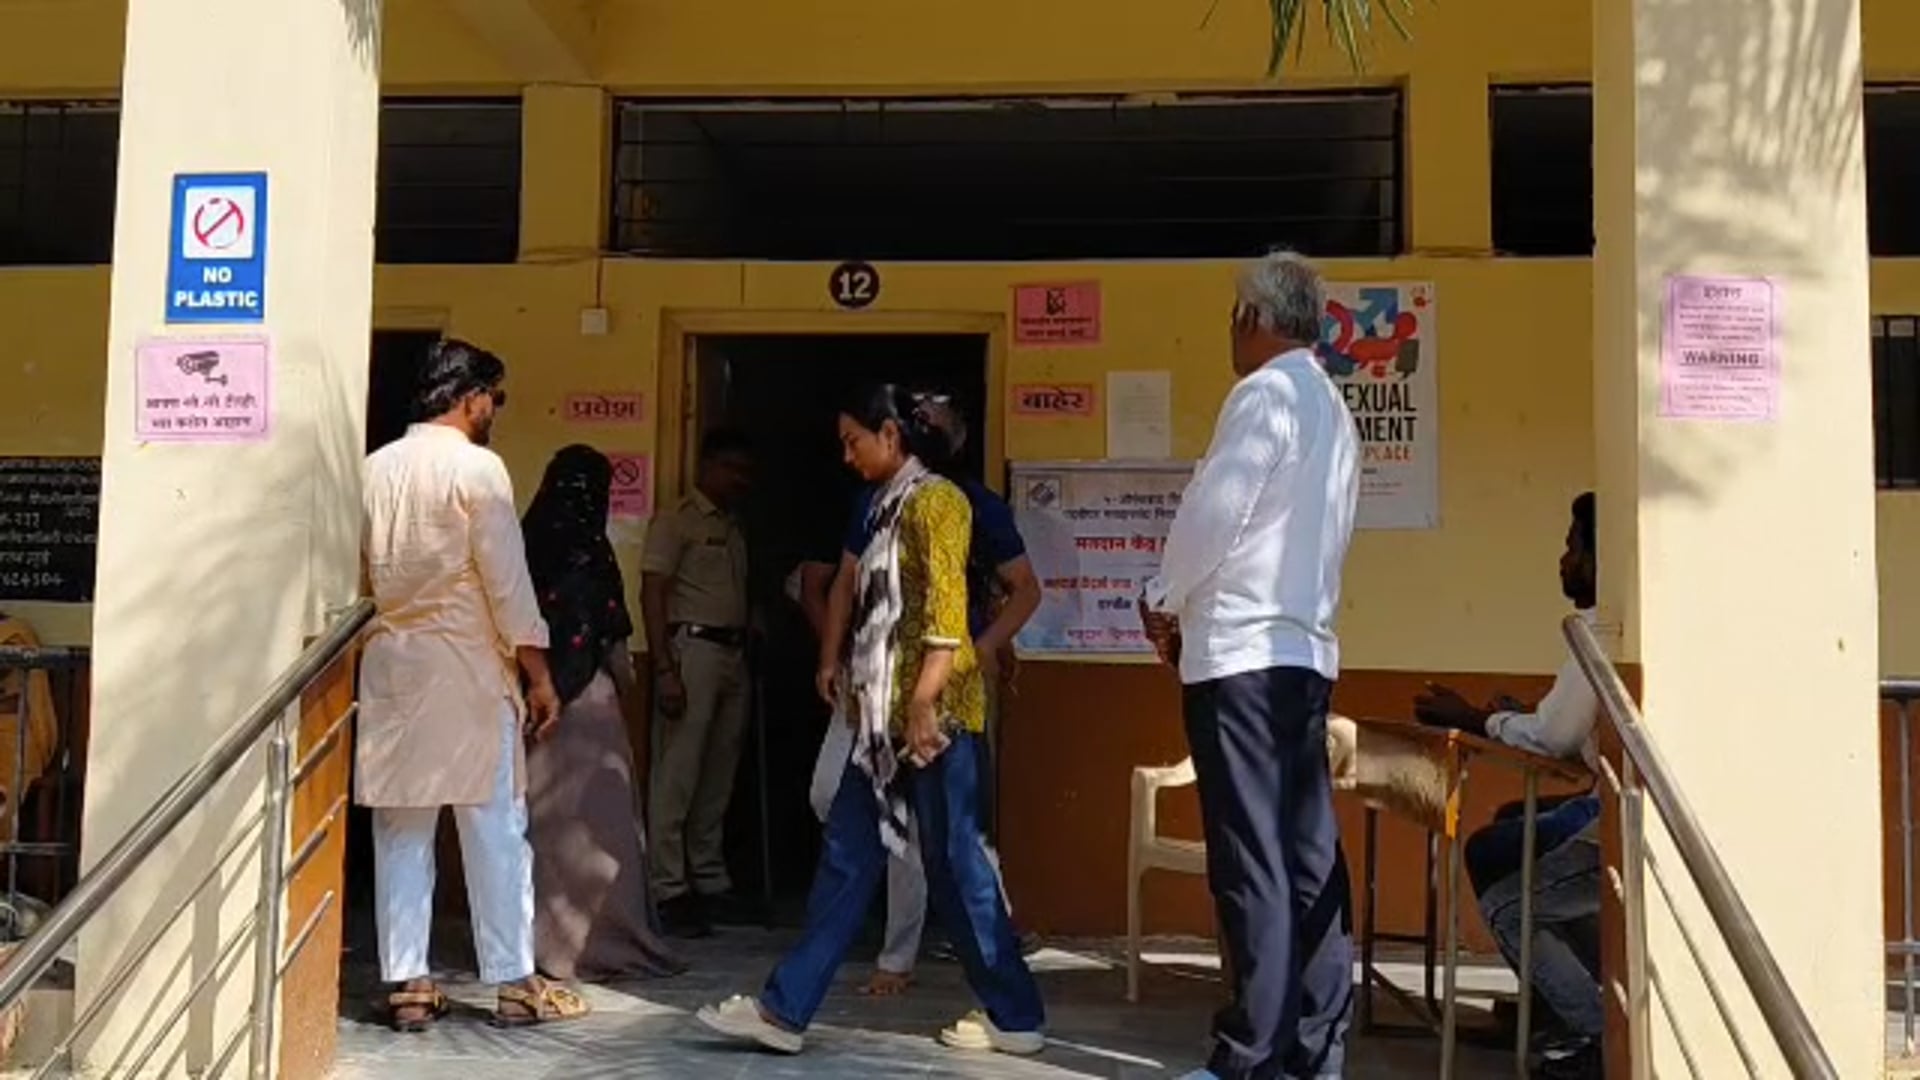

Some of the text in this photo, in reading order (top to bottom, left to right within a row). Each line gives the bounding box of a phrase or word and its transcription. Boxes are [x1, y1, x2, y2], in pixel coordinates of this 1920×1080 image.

[203, 266, 232, 283] NO
[839, 271, 871, 299] 12
[174, 290, 259, 307] PLASTIC
[1682, 350, 1759, 365] WARNING
[572, 396, 635, 417] प्रवेश
[1023, 386, 1083, 409] बाहेर
[1337, 383, 1417, 413] EXUAL
[1354, 416, 1417, 441] MENT
[1363, 446, 1411, 461] PLACE
[1074, 535, 1125, 551] मतदान
